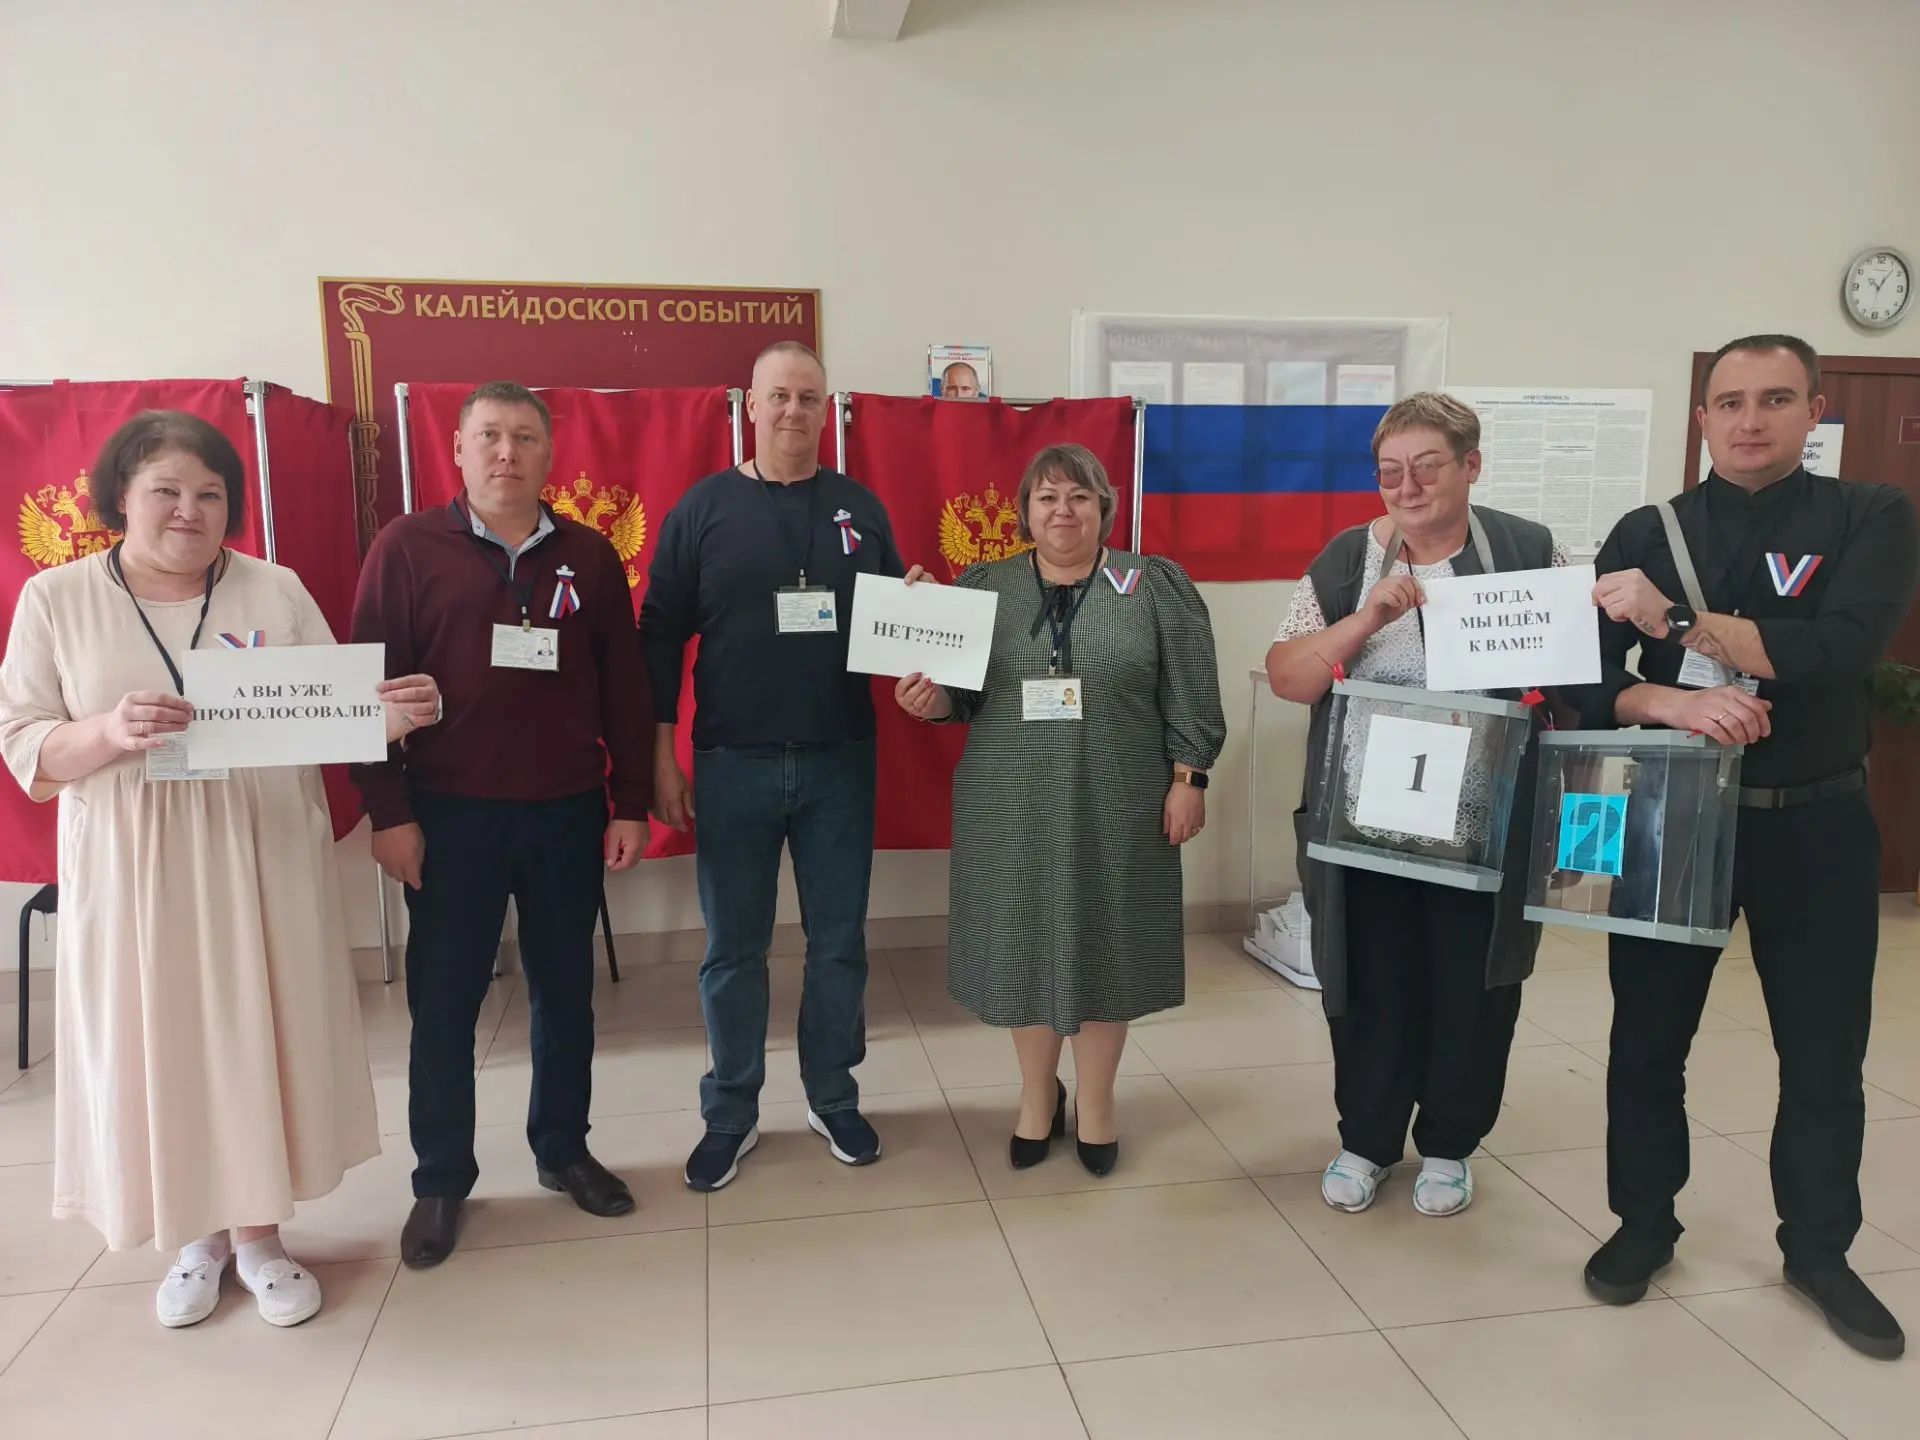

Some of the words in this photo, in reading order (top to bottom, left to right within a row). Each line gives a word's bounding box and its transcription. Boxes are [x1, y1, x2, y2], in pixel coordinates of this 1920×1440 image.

[414, 289, 649, 324] КАЛЕЙДОСКОП
[658, 296, 803, 324] СОБЫТИЙ
[1473, 589, 1534, 605] ТОГДА
[1460, 615, 1492, 630] МЫ
[1497, 609, 1552, 628] ИДЁМ
[872, 620, 964, 649] НЕТ???!!!
[1469, 640, 1481, 652] К
[1486, 636, 1543, 652] ВАМ!!!
[233, 686, 246, 698] А
[252, 685, 283, 698] ВЫ
[289, 683, 333, 697] УЖЕ
[192, 704, 381, 721] ПРОГОЛОСОВАЛИ?
[1405, 753, 1428, 793] 1
[1566, 801, 1621, 873] 2
